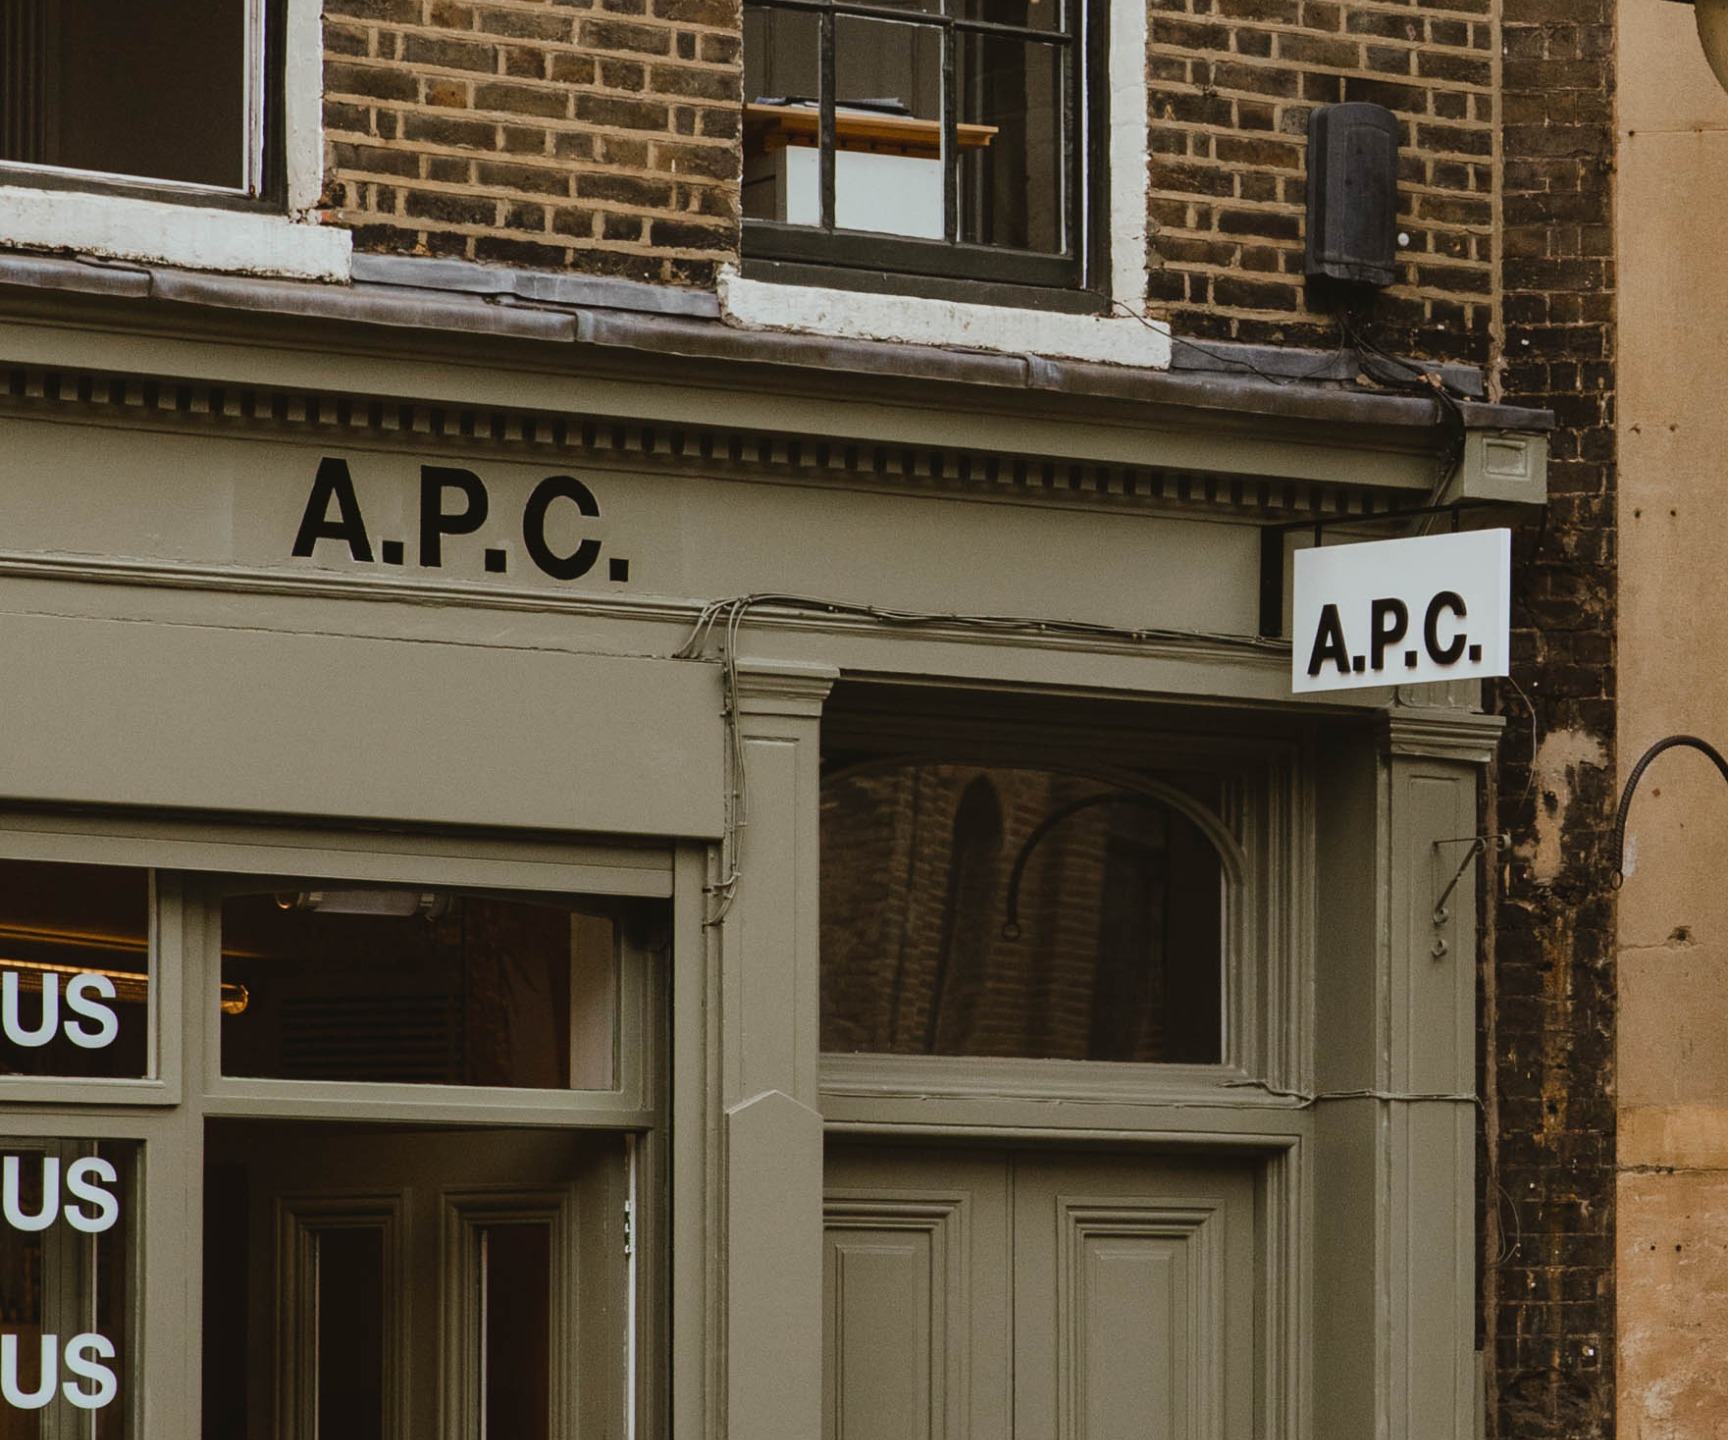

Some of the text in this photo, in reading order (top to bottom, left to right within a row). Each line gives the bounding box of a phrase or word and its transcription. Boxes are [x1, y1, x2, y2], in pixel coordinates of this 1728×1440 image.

[291, 456, 630, 583] A.P.C.
[1306, 590, 1484, 677] A.P.C.
[2, 969, 120, 1049] US
[2, 1155, 119, 1233] US
[0, 1332, 118, 1411] US
